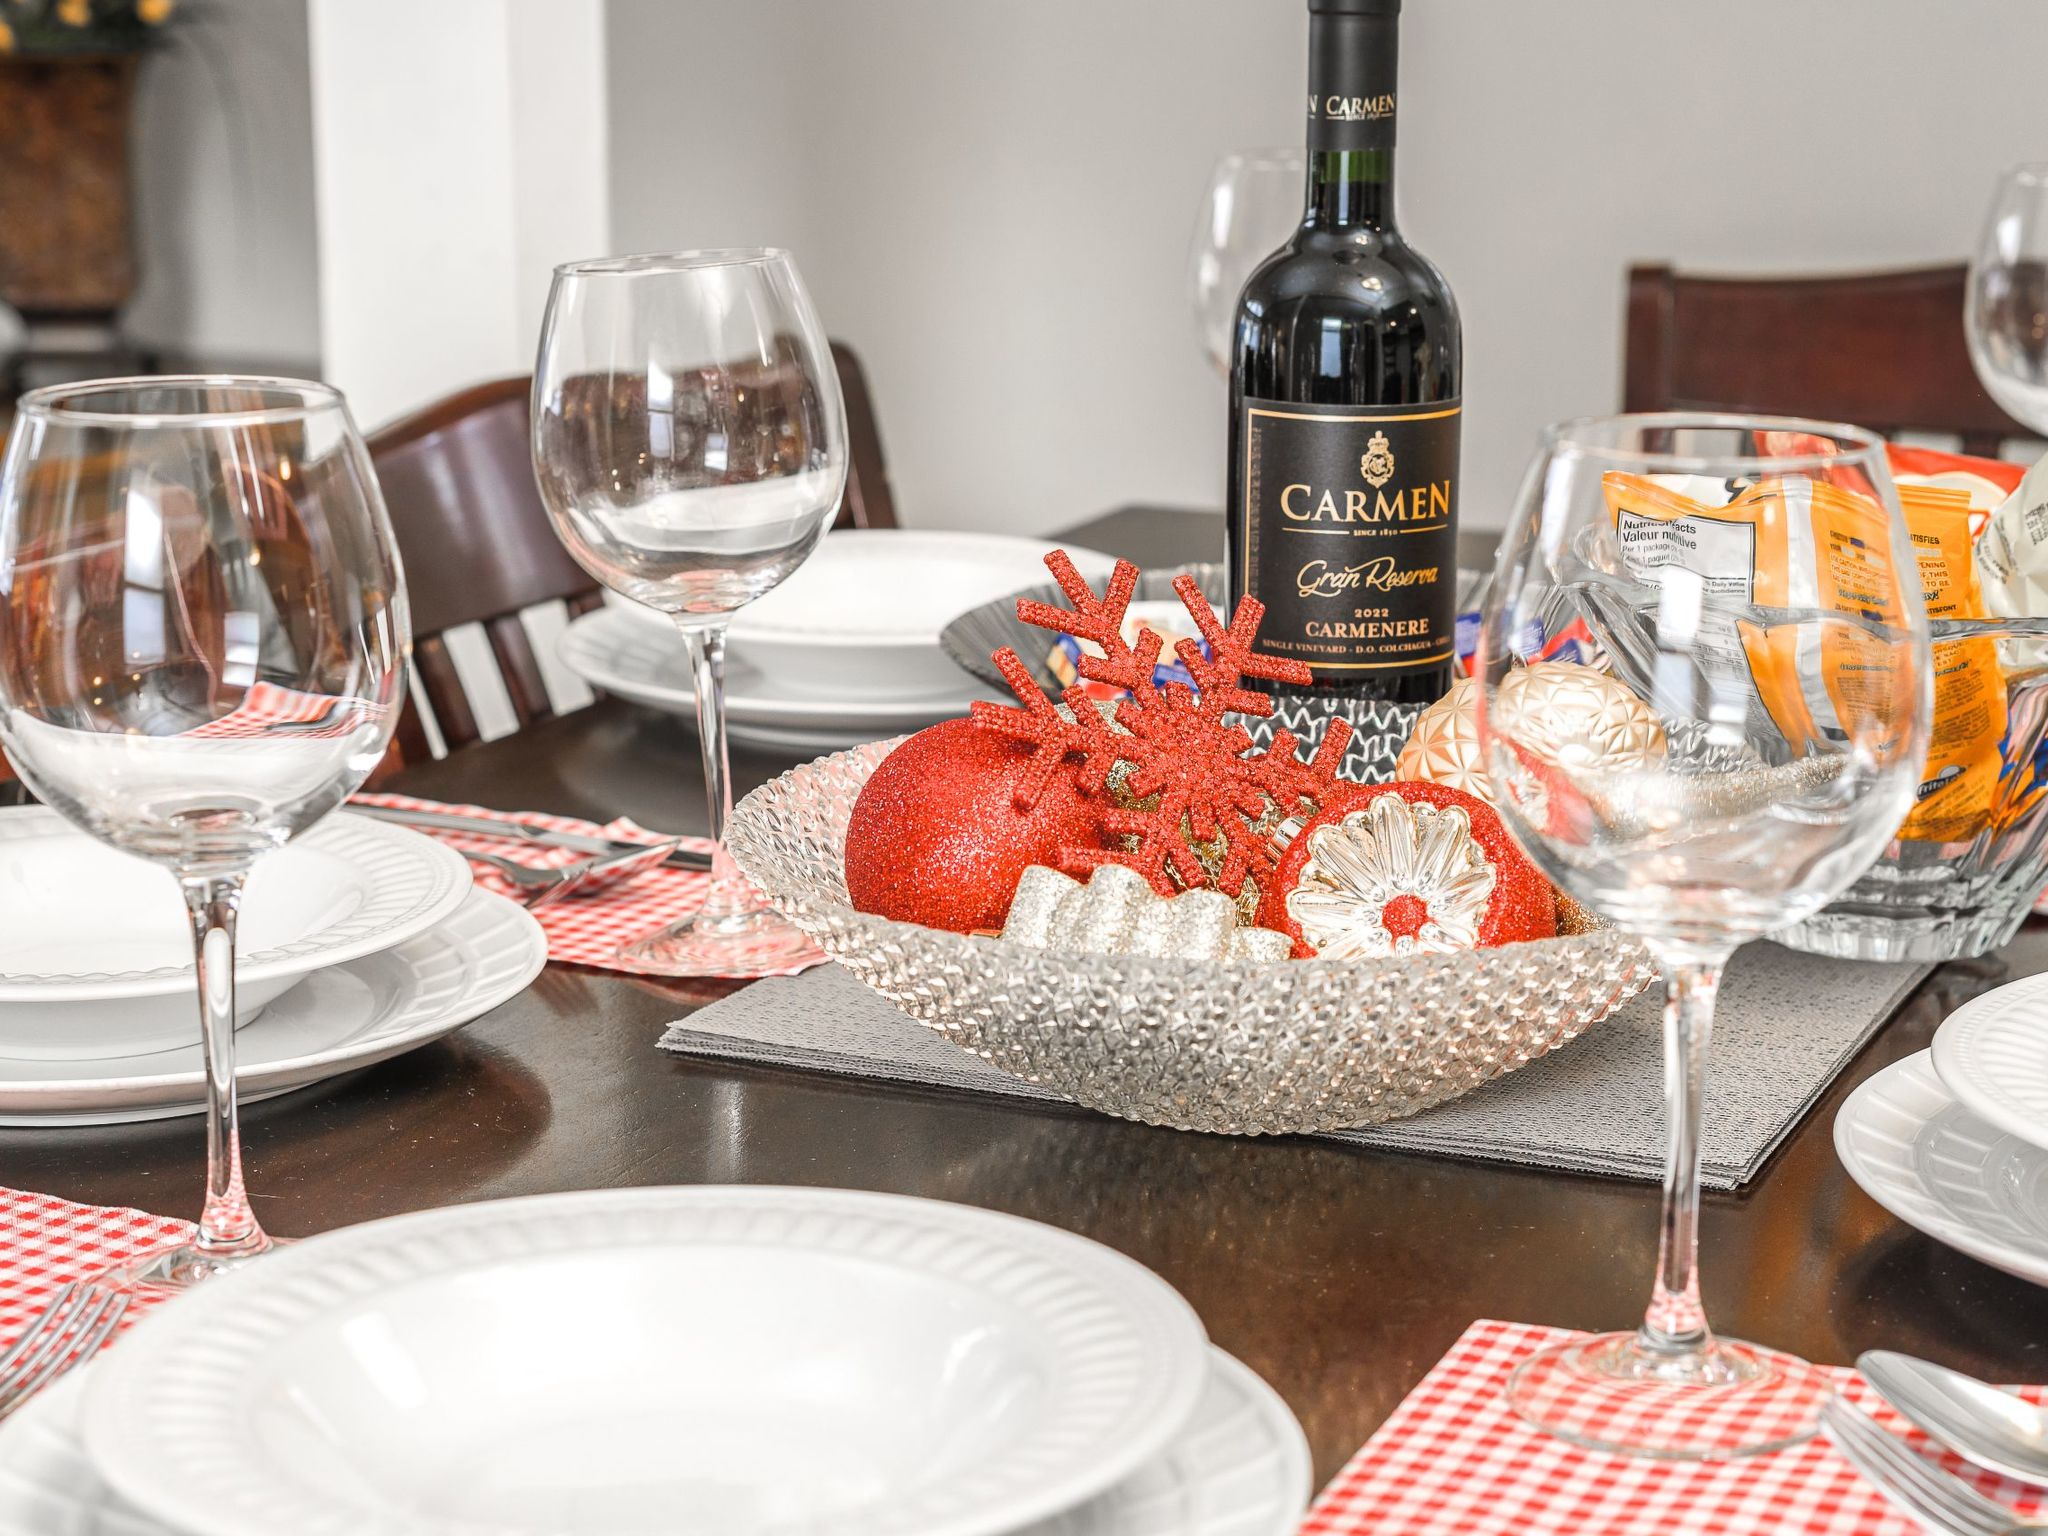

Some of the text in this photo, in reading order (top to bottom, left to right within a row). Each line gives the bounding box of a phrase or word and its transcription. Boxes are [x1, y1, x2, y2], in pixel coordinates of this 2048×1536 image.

[1326, 92, 1395, 115] CARMEN
[1280, 480, 1450, 522] CARMEN
[1353, 529, 1377, 537] SINCE
[1672, 521, 1697, 534] acts
[1622, 530, 1660, 542] Valeur
[1910, 533, 1941, 545] TISFIES
[1917, 561, 1947, 569] ENING
[1296, 556, 1439, 598] Gran Reserva
[1354, 608, 1389, 618] 2022
[1305, 618, 1430, 638] CARMENERE
[1263, 639, 1293, 650] SINGLE
[1295, 642, 1347, 654] VINEYARD
[1379, 642, 1431, 653] COLCHAGUA
